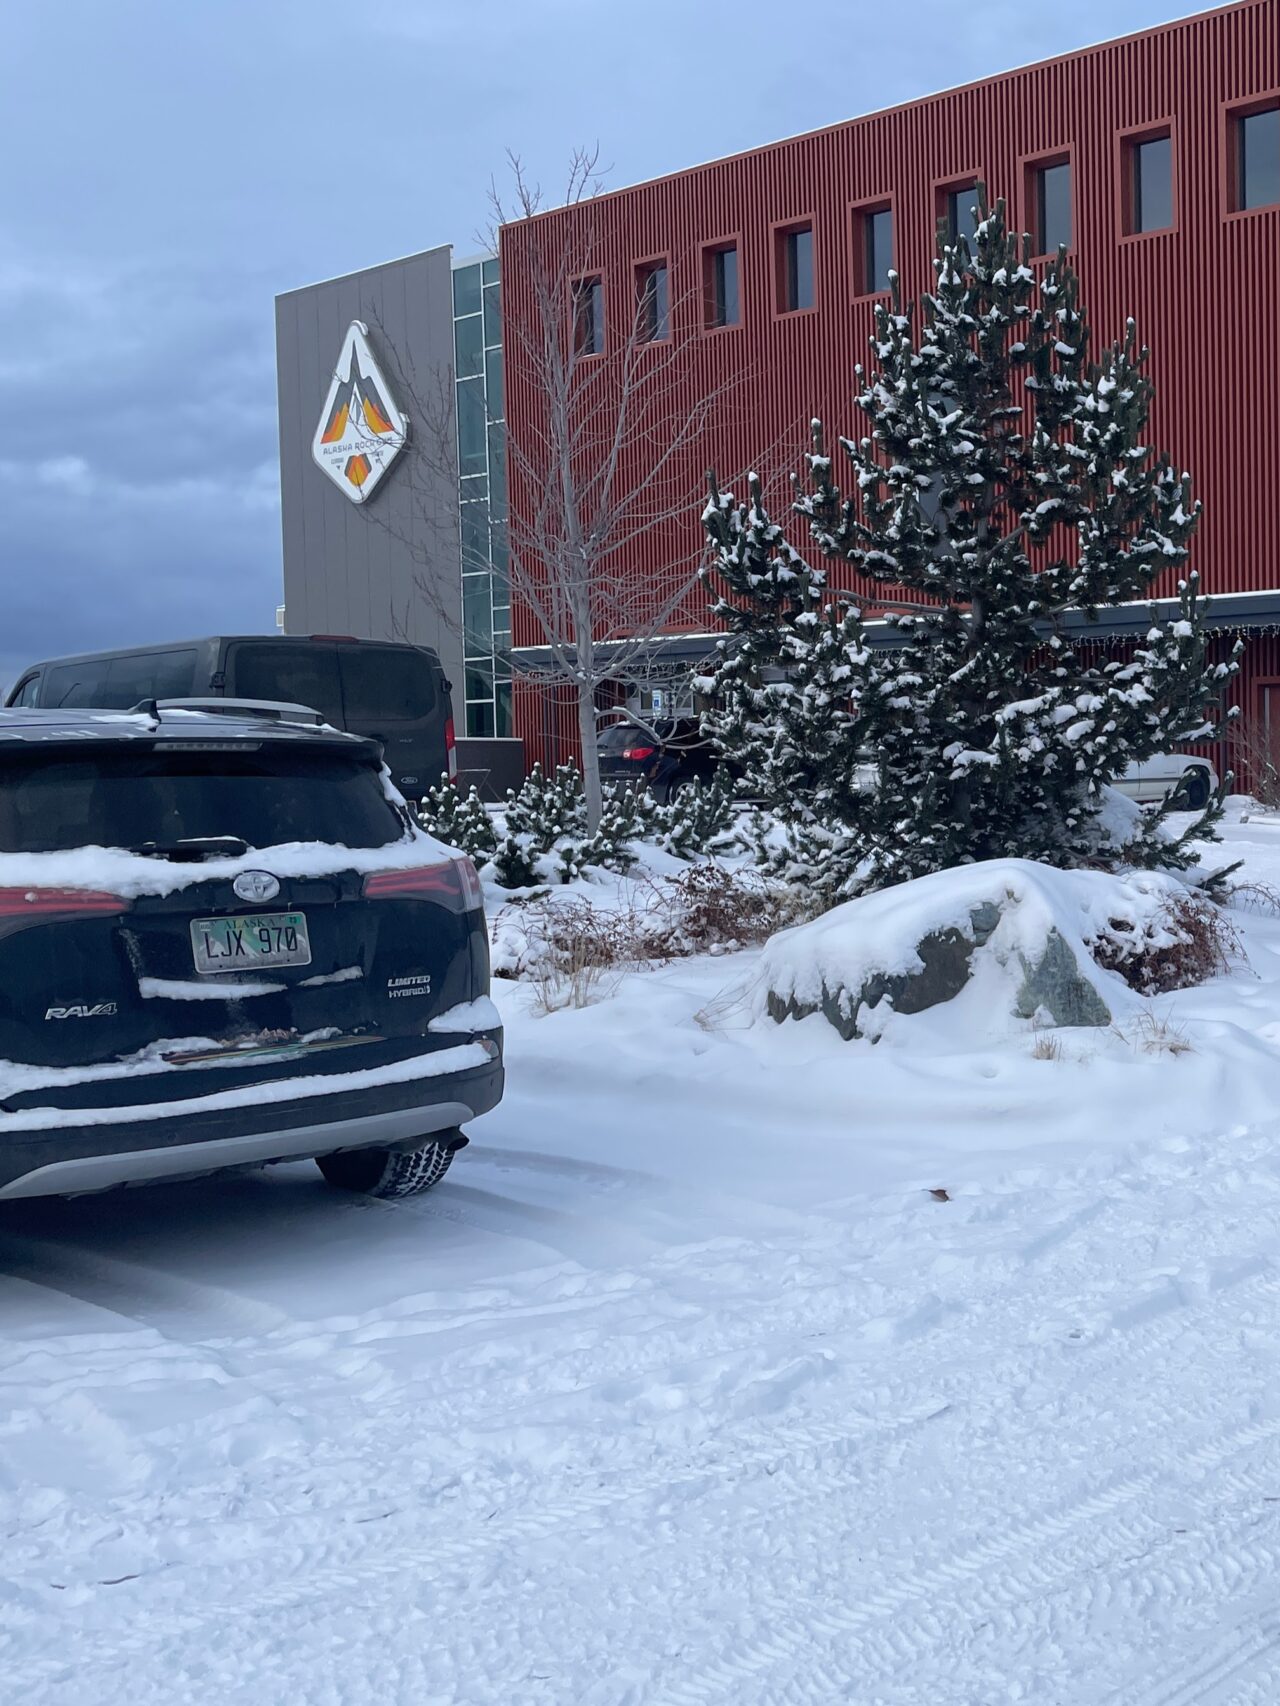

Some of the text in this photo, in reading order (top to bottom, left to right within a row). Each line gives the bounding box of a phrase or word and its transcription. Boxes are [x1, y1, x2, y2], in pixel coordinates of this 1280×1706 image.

[323, 443, 353, 455] ALASKA
[225, 918, 276, 930] ALASKA
[204, 926, 298, 958] LJX 970
[387, 975, 431, 987] LIMITED
[44, 1002, 118, 1021] RAV4
